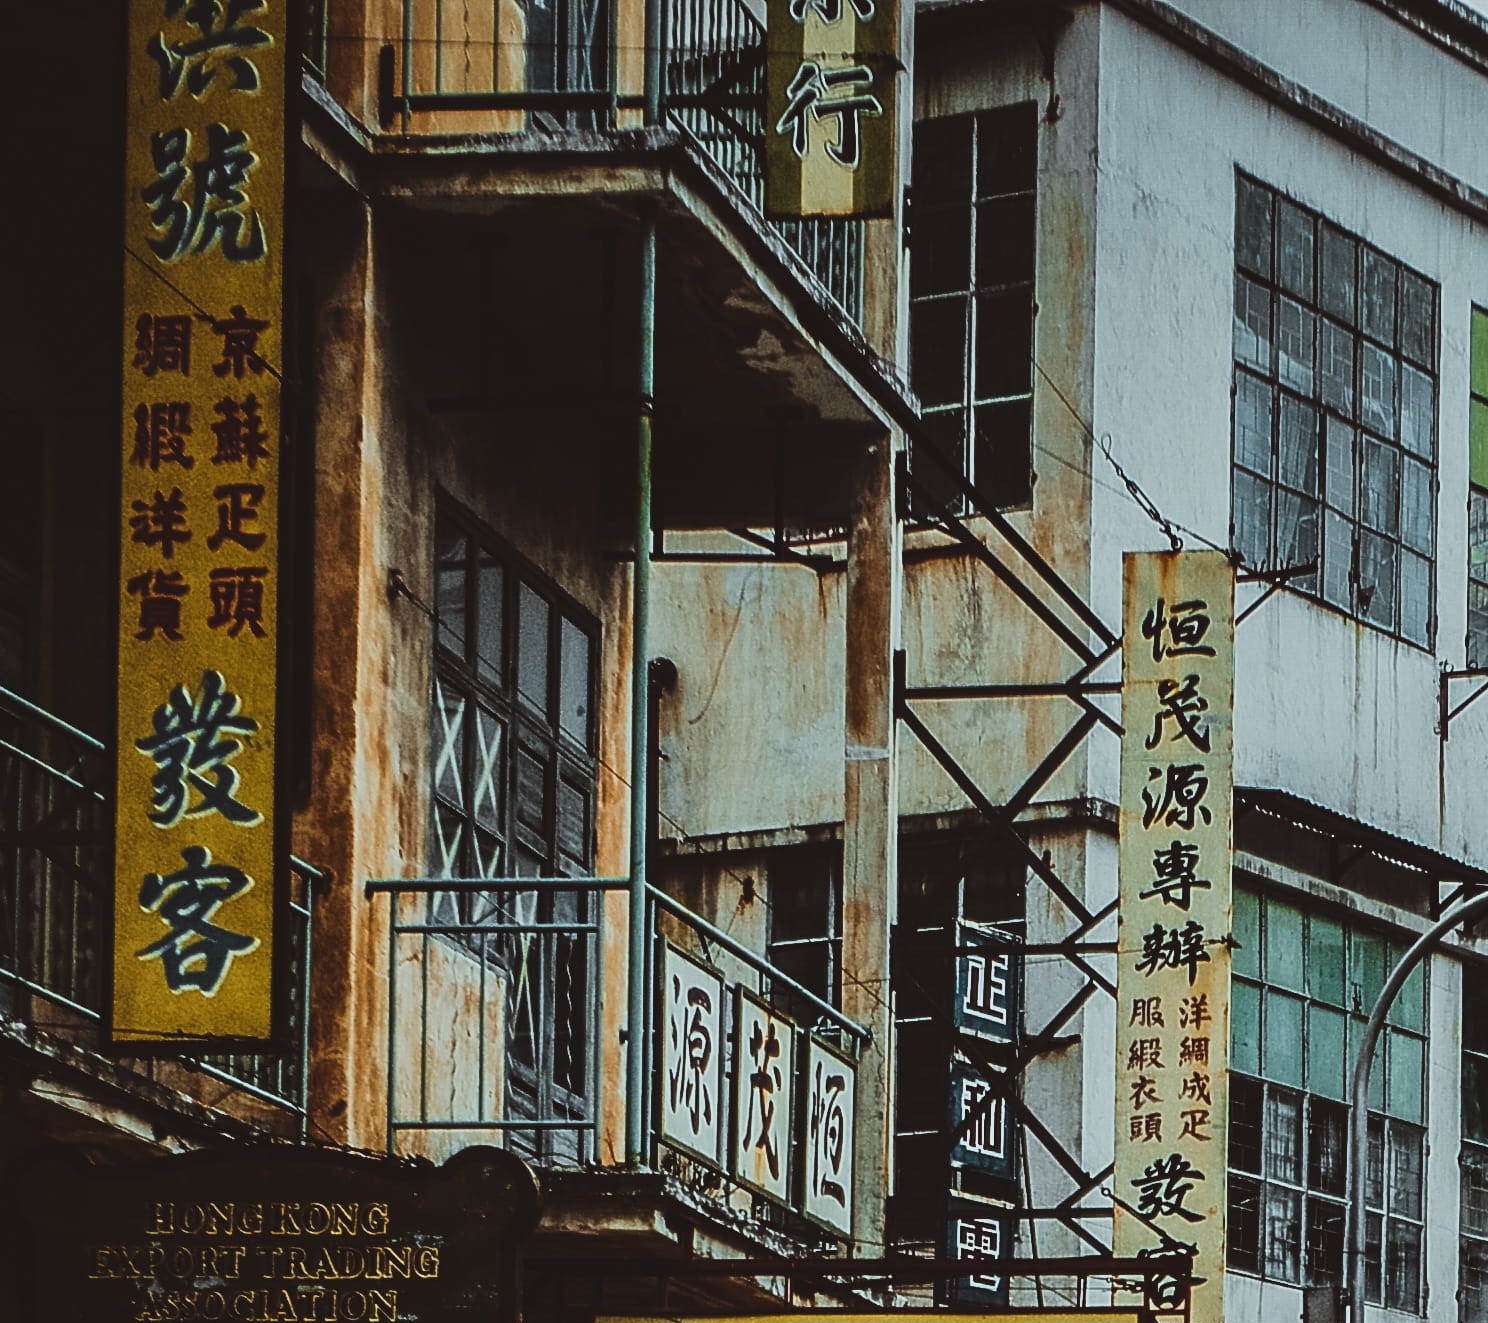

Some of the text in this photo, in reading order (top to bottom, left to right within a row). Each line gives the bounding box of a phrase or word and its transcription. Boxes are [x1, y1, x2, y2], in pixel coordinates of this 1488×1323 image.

[145, 1202, 390, 1236] HONG KONG
[88, 1246, 440, 1280] EXPORT TRADING
[135, 1289, 399, 1322] ASSOCIATION
